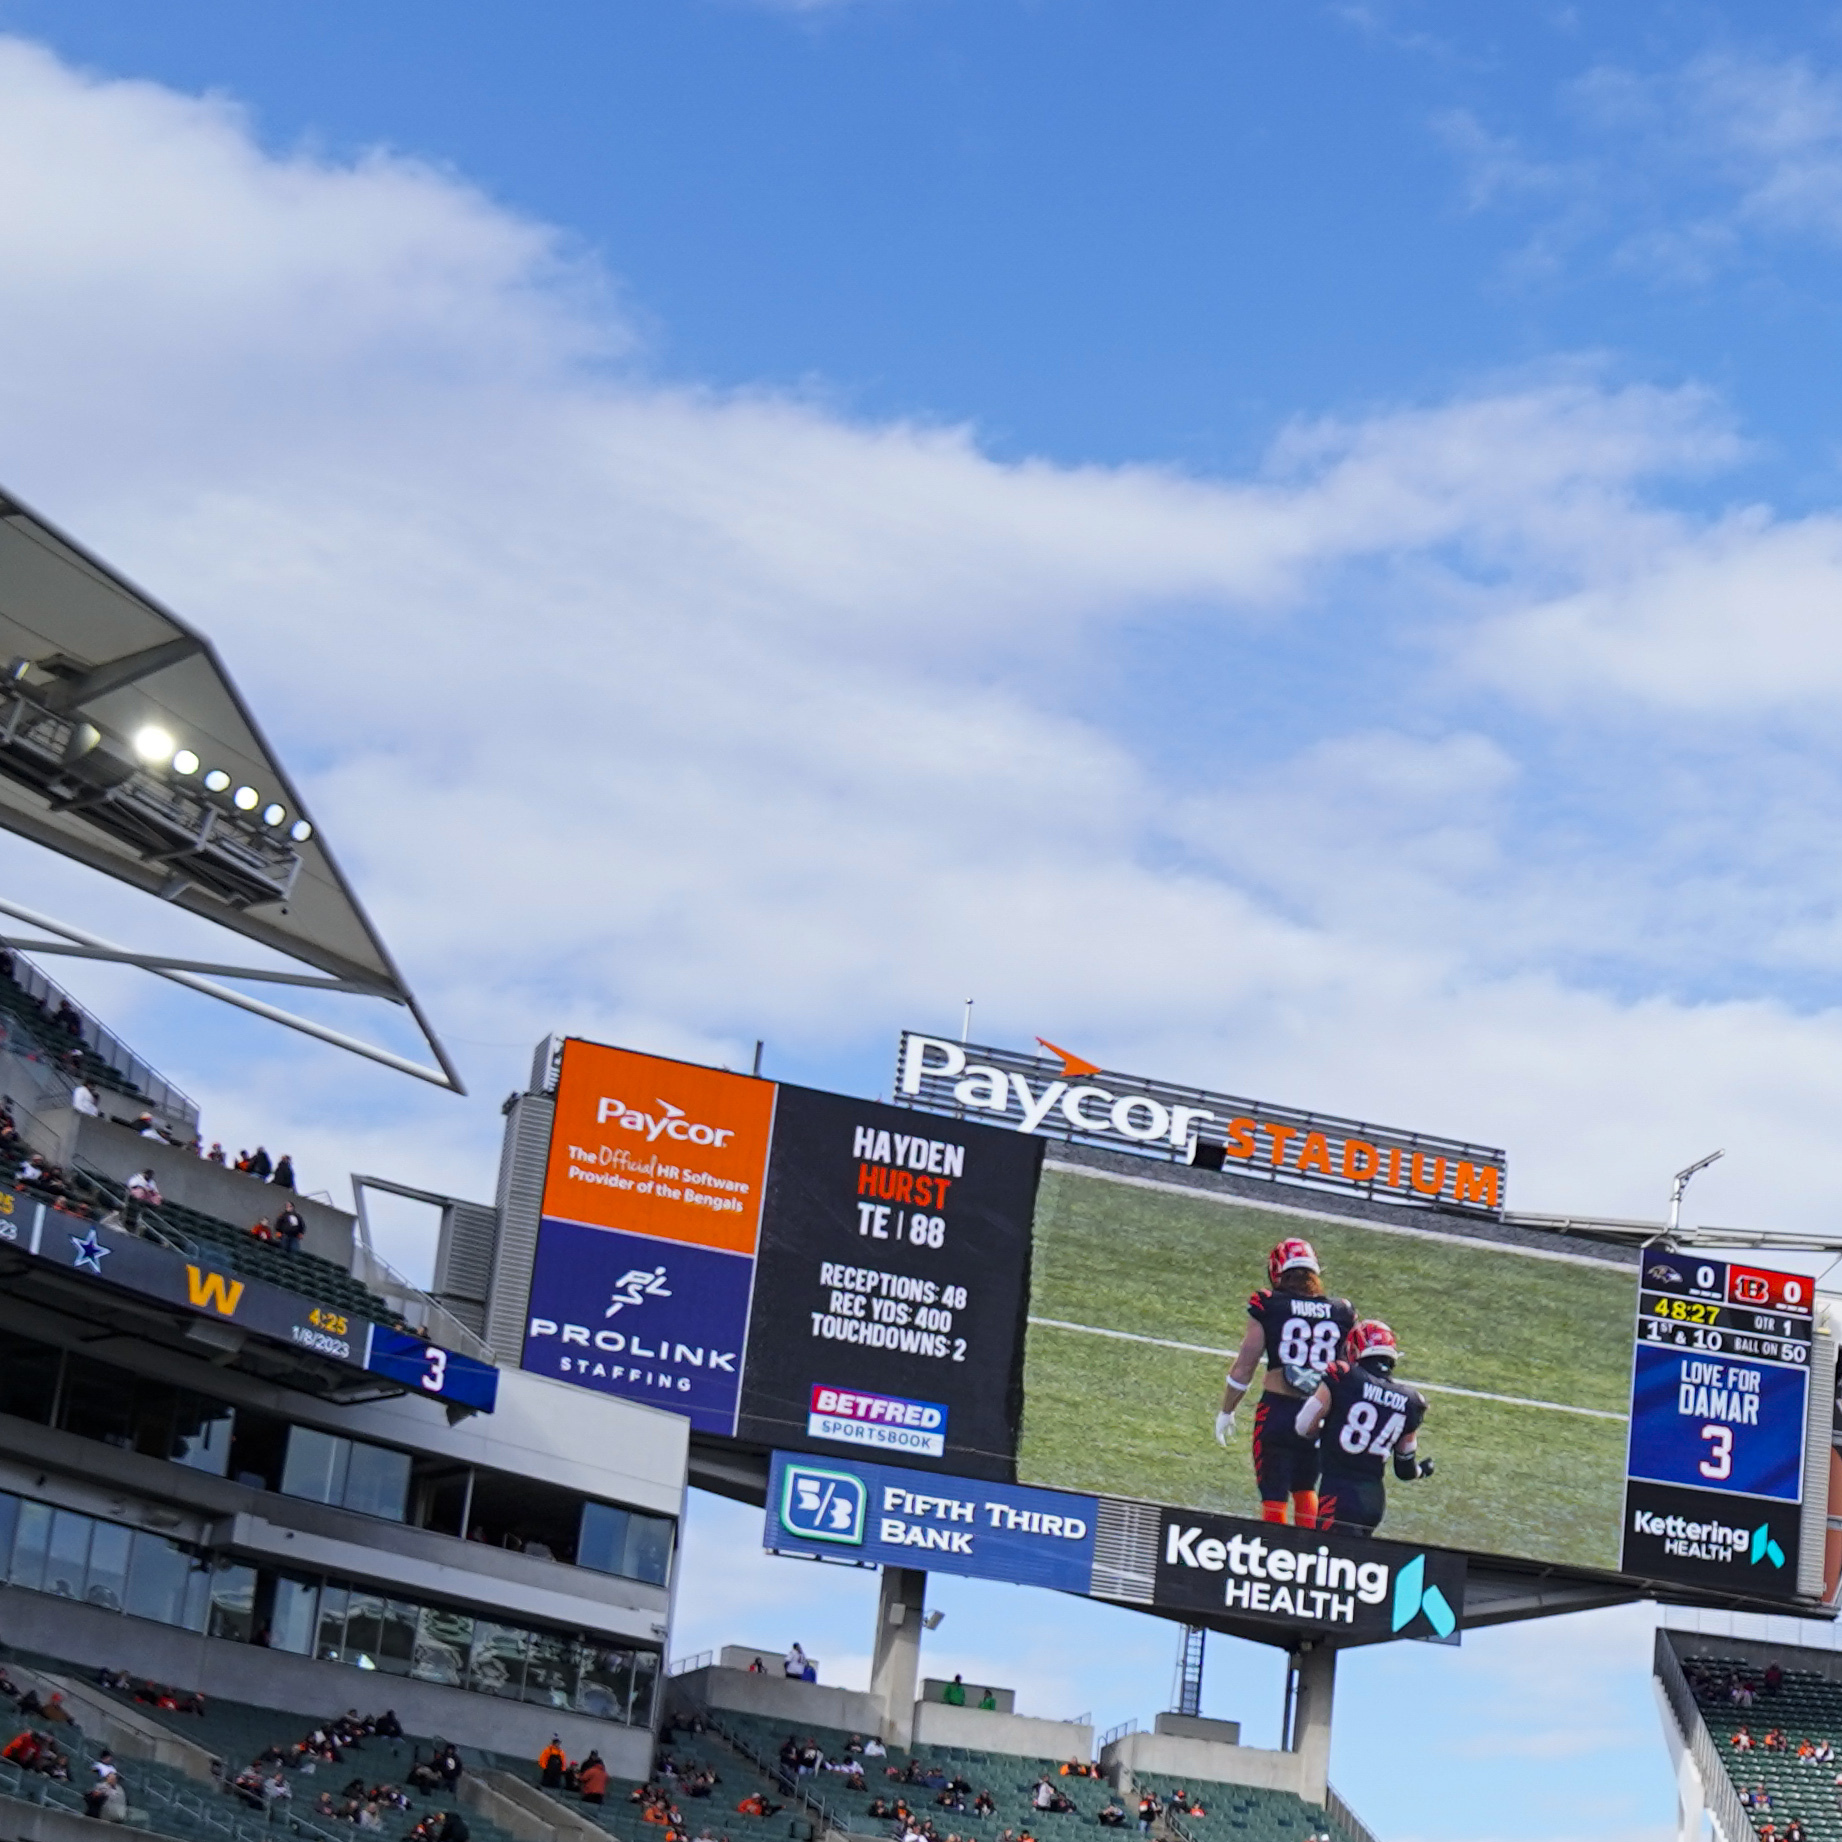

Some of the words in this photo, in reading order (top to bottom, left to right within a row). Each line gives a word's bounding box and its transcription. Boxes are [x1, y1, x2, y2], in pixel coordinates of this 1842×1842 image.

[597, 1097, 735, 1147] Paycor
[903, 1035, 1214, 1147] Paycor
[1227, 1117, 1499, 1207] STADIUM
[568, 1145, 597, 1163] The
[599, 1145, 657, 1178] Official
[657, 1163, 679, 1180] HR
[682, 1168, 749, 1194] Software
[853, 1125, 965, 1178] HAYDEN
[568, 1165, 634, 1190] Provider
[637, 1180, 654, 1194] of
[654, 1183, 681, 1200] the
[683, 1188, 743, 1213] Bengals
[857, 1163, 952, 1210] HURST
[857, 1201, 891, 1239] TE
[909, 1213, 946, 1249] 88
[820, 1261, 940, 1304] RECEPTIONS:
[941, 1285, 968, 1310] 48
[1696, 1265, 1715, 1289] 0
[1783, 1281, 1802, 1304] 0
[308, 1307, 348, 1336] 4:25
[829, 1290, 867, 1318] REC
[871, 1296, 912, 1325] YDS:
[914, 1306, 953, 1333] 400
[1291, 1299, 1333, 1319] HURST
[1655, 1298, 1720, 1326] 48:27
[1754, 1315, 1775, 1332] QTR
[1783, 1320, 1792, 1337] 1
[291, 1324, 350, 1360] 1/8/2023
[530, 1317, 736, 1372] PROLINK
[811, 1312, 951, 1358] TOUCHDOWNS:
[952, 1338, 967, 1362] 2
[1278, 1317, 1341, 1372] 88
[1675, 1330, 1686, 1345] &
[1692, 1329, 1722, 1351] 10
[1734, 1336, 1759, 1353] BALL
[1761, 1342, 1778, 1356] ON
[1781, 1345, 1807, 1363] 50
[421, 1347, 447, 1392] 3
[560, 1356, 691, 1392] STAFFING
[1680, 1359, 1723, 1389] LOVE
[1727, 1366, 1761, 1393] FOR
[816, 1388, 942, 1429] BETFRED
[1363, 1382, 1408, 1412] WILCOX
[1678, 1383, 1760, 1425] DAMAR
[822, 1420, 931, 1449] SPORTSBOOK
[1339, 1401, 1407, 1463] 84
[1699, 1424, 1733, 1480] 3
[880, 1518, 974, 1554] BANK
[883, 1486, 975, 1524] FIFTH
[984, 1501, 1088, 1541] THIRD
[1634, 1510, 1750, 1552] Kettering
[1165, 1523, 1389, 1605] Kettering
[1664, 1539, 1733, 1562] HEALTH
[1225, 1577, 1355, 1624] HEALTH
